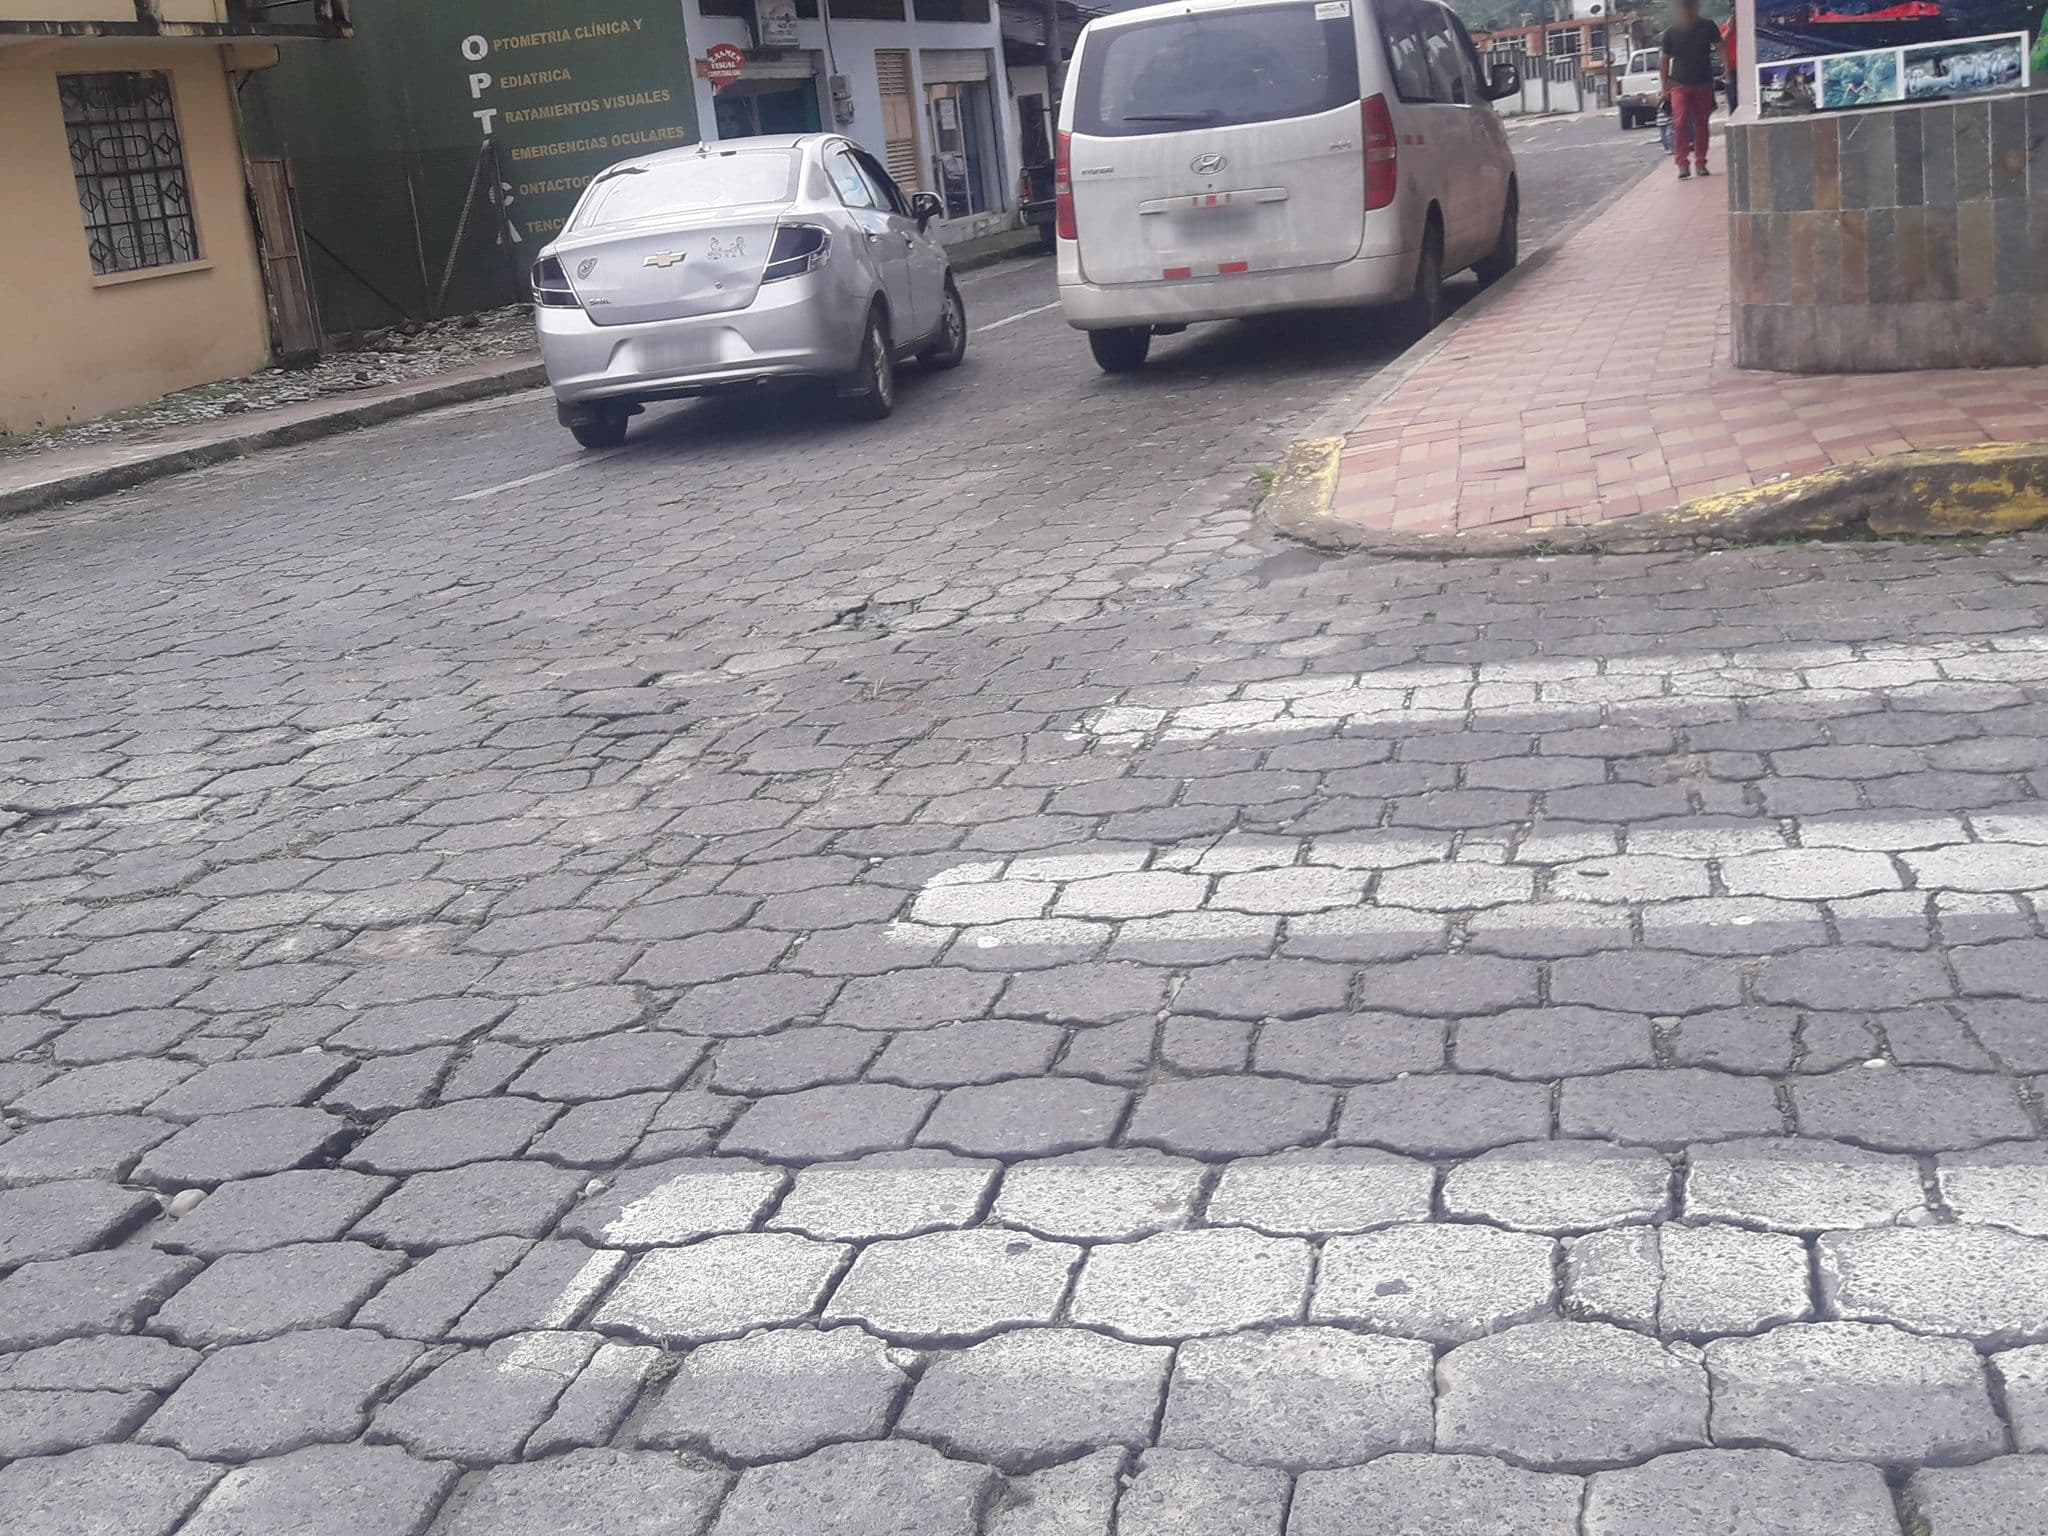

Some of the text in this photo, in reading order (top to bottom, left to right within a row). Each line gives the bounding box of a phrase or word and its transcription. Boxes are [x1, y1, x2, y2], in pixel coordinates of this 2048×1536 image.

[633, 18, 644, 31] Y
[711, 61, 737, 69] VISUAL
[603, 89, 671, 109] VISUALES
[511, 126, 685, 161] EMERGENCIAS OCULARES
